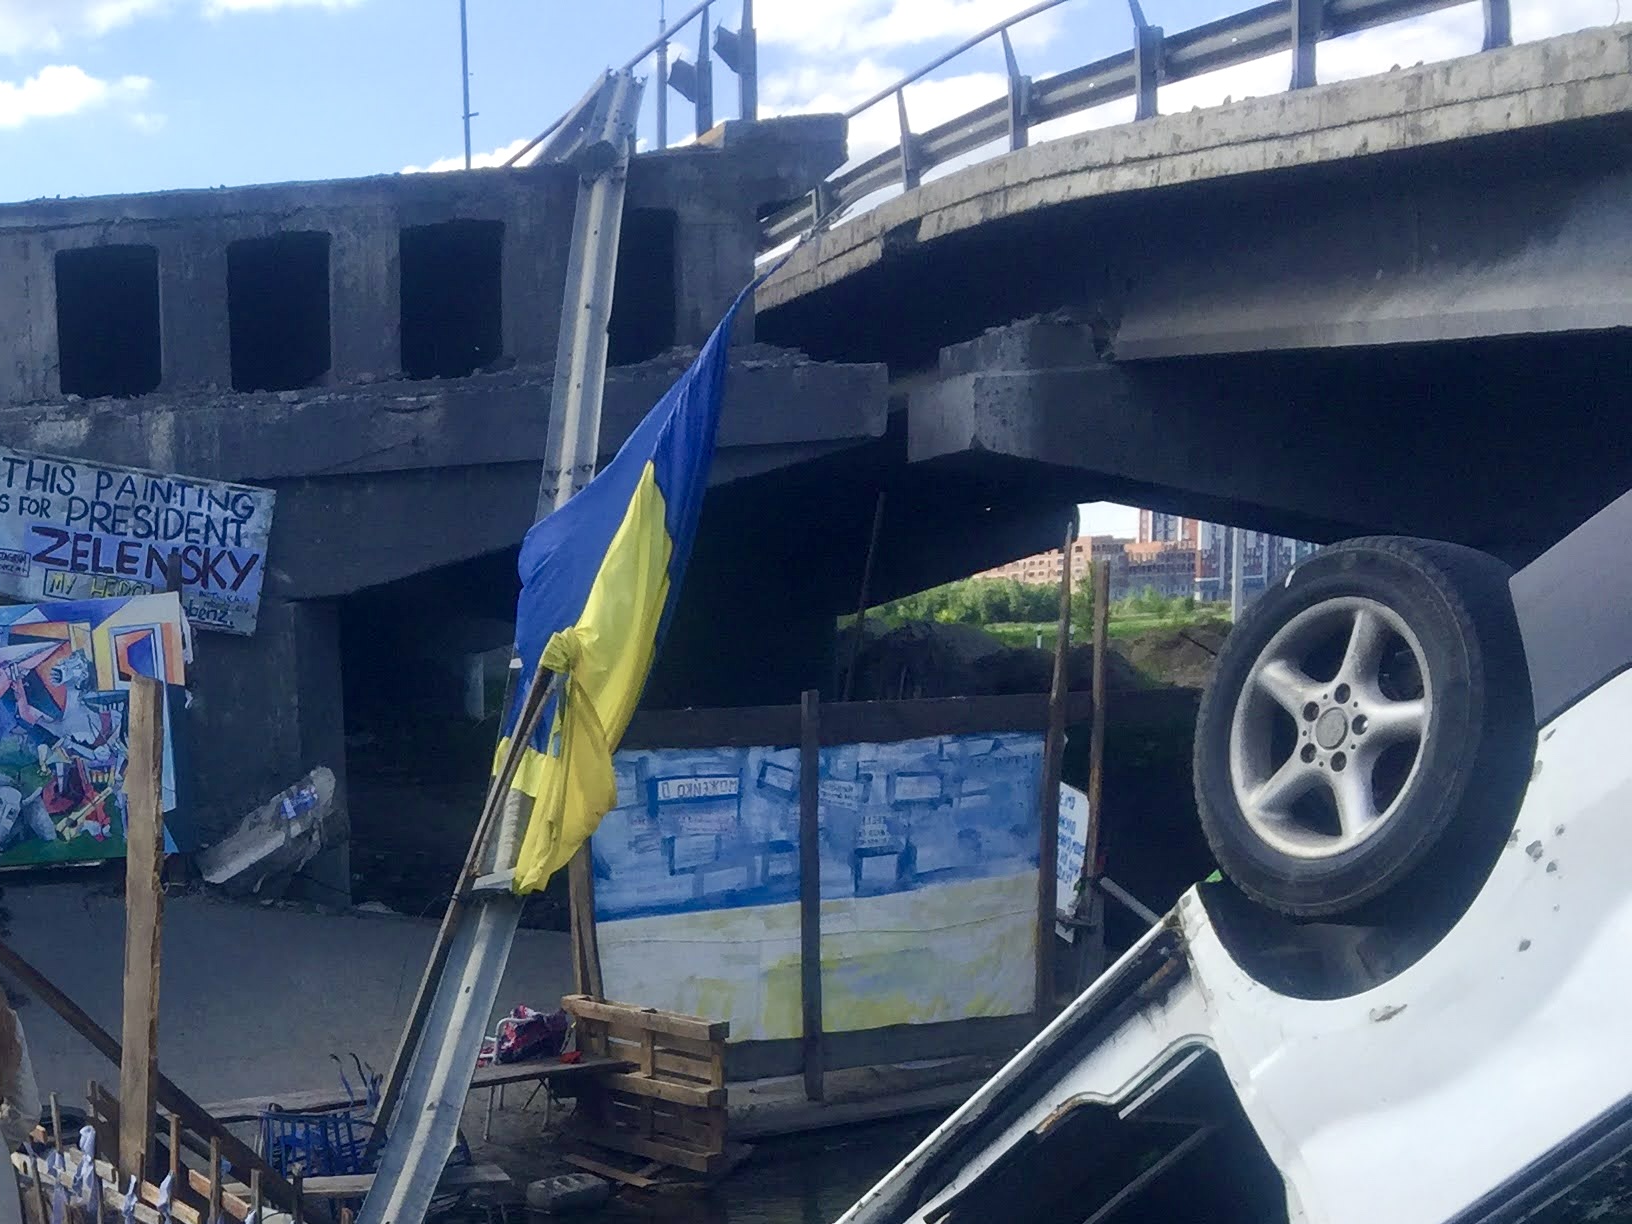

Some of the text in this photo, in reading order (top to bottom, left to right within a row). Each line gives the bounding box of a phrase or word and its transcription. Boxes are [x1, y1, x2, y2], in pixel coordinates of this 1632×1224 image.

[2, 457, 255, 520] THIS PAINTING
[19, 496, 51, 518] FOR
[65, 496, 247, 547] PRESIDENT
[31, 525, 260, 592] ZELENSKY
[55, 573, 77, 594] MY
